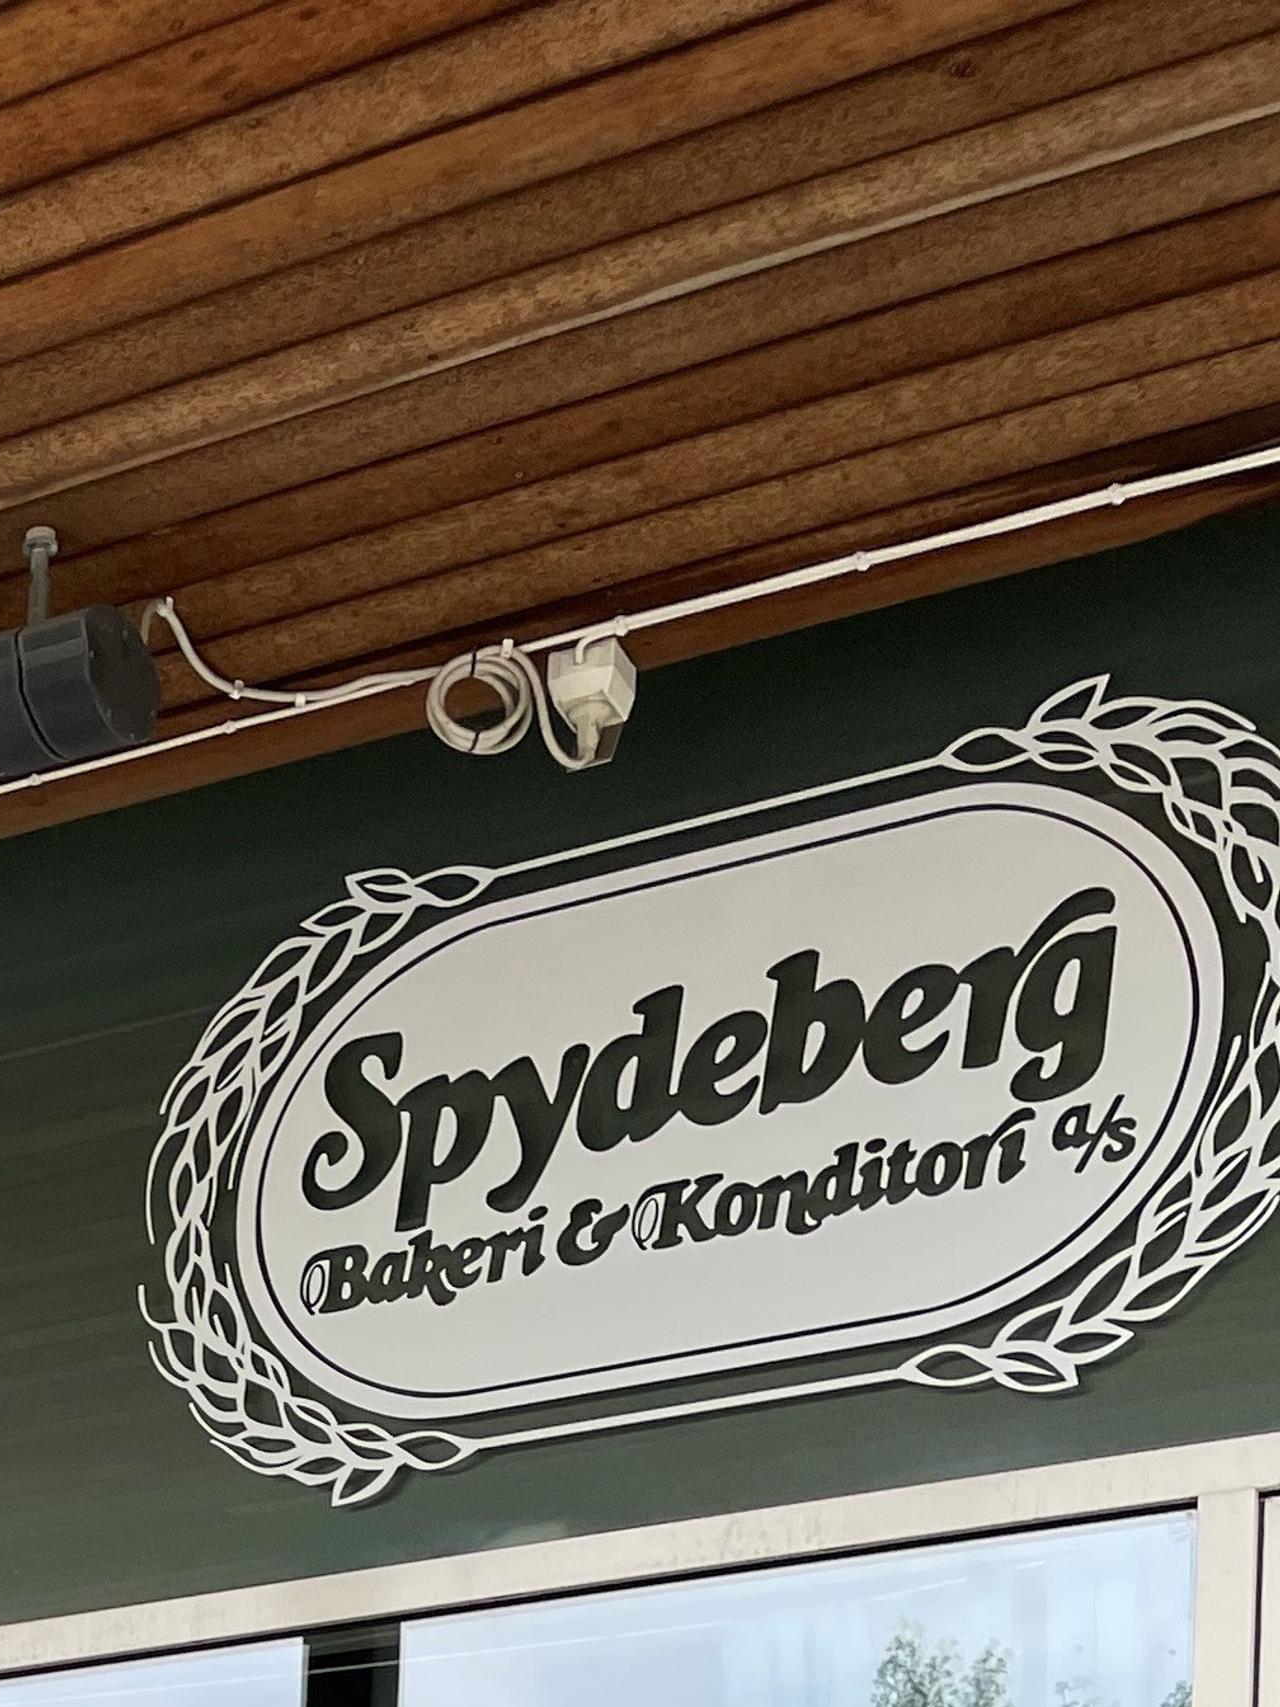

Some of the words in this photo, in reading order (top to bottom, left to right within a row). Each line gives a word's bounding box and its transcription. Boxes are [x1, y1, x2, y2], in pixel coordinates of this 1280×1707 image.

[302, 886, 1117, 1233] Spydeberg
[300, 1205, 548, 1317] Bakeri
[555, 1198, 631, 1265] &
[632, 1105, 1037, 1251] Konditori
